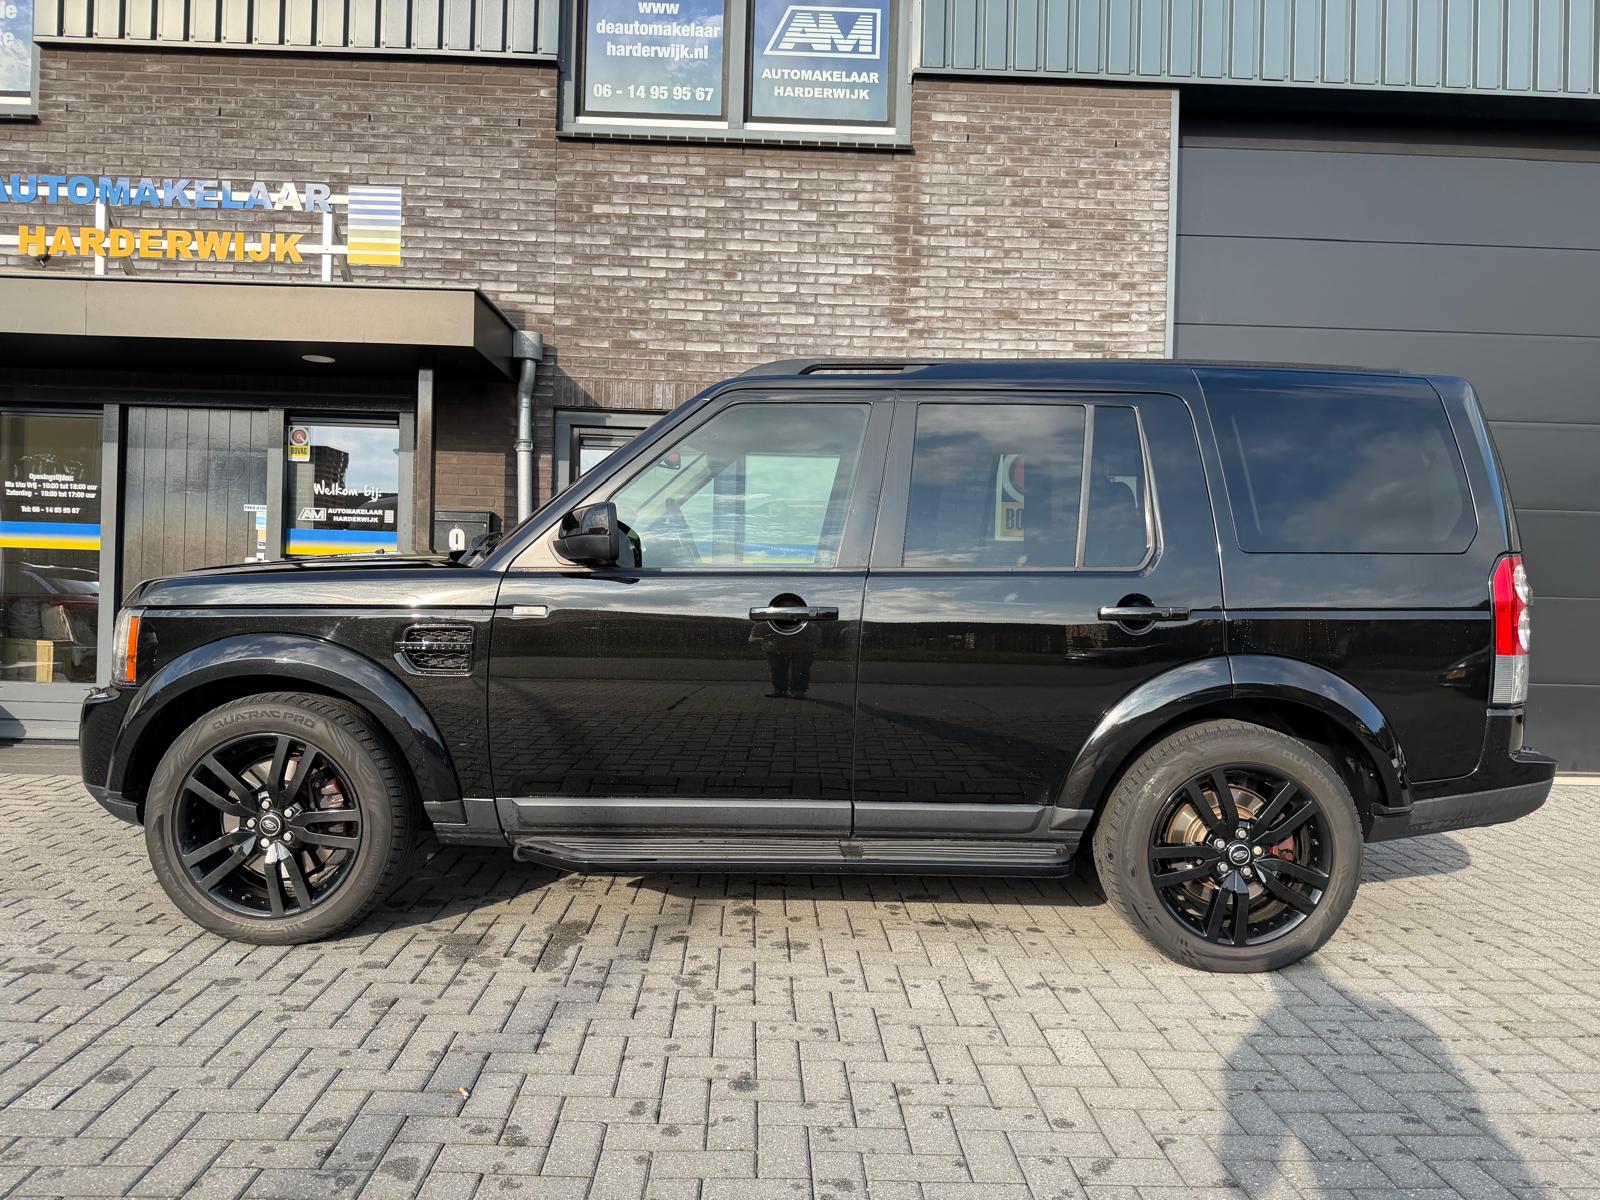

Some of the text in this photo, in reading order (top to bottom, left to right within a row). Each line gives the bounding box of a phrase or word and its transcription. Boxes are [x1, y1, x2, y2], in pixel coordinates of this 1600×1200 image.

[638, 2, 679, 15] www
[596, 19, 721, 37] deautomakelaar
[777, 12, 874, 53] AM
[606, 42, 709, 61] harderwijk.nl
[762, 68, 879, 84] AUTOMAKELAAR
[593, 83, 612, 97] 06
[628, 84, 646, 99] 14
[650, 85, 669, 100] 95
[672, 86, 691, 101] 95
[695, 87, 714, 102] 67
[773, 86, 870, 100] HARDERWIJK
[18, 225, 304, 263] HARDERWIJK
[314, 479, 382, 502] Welkom bij:
[328, 507, 384, 515] AUTOMAKELAAR
[333, 516, 379, 524] HARDERWIJK
[212, 710, 316, 730] QUATRAC PRO
